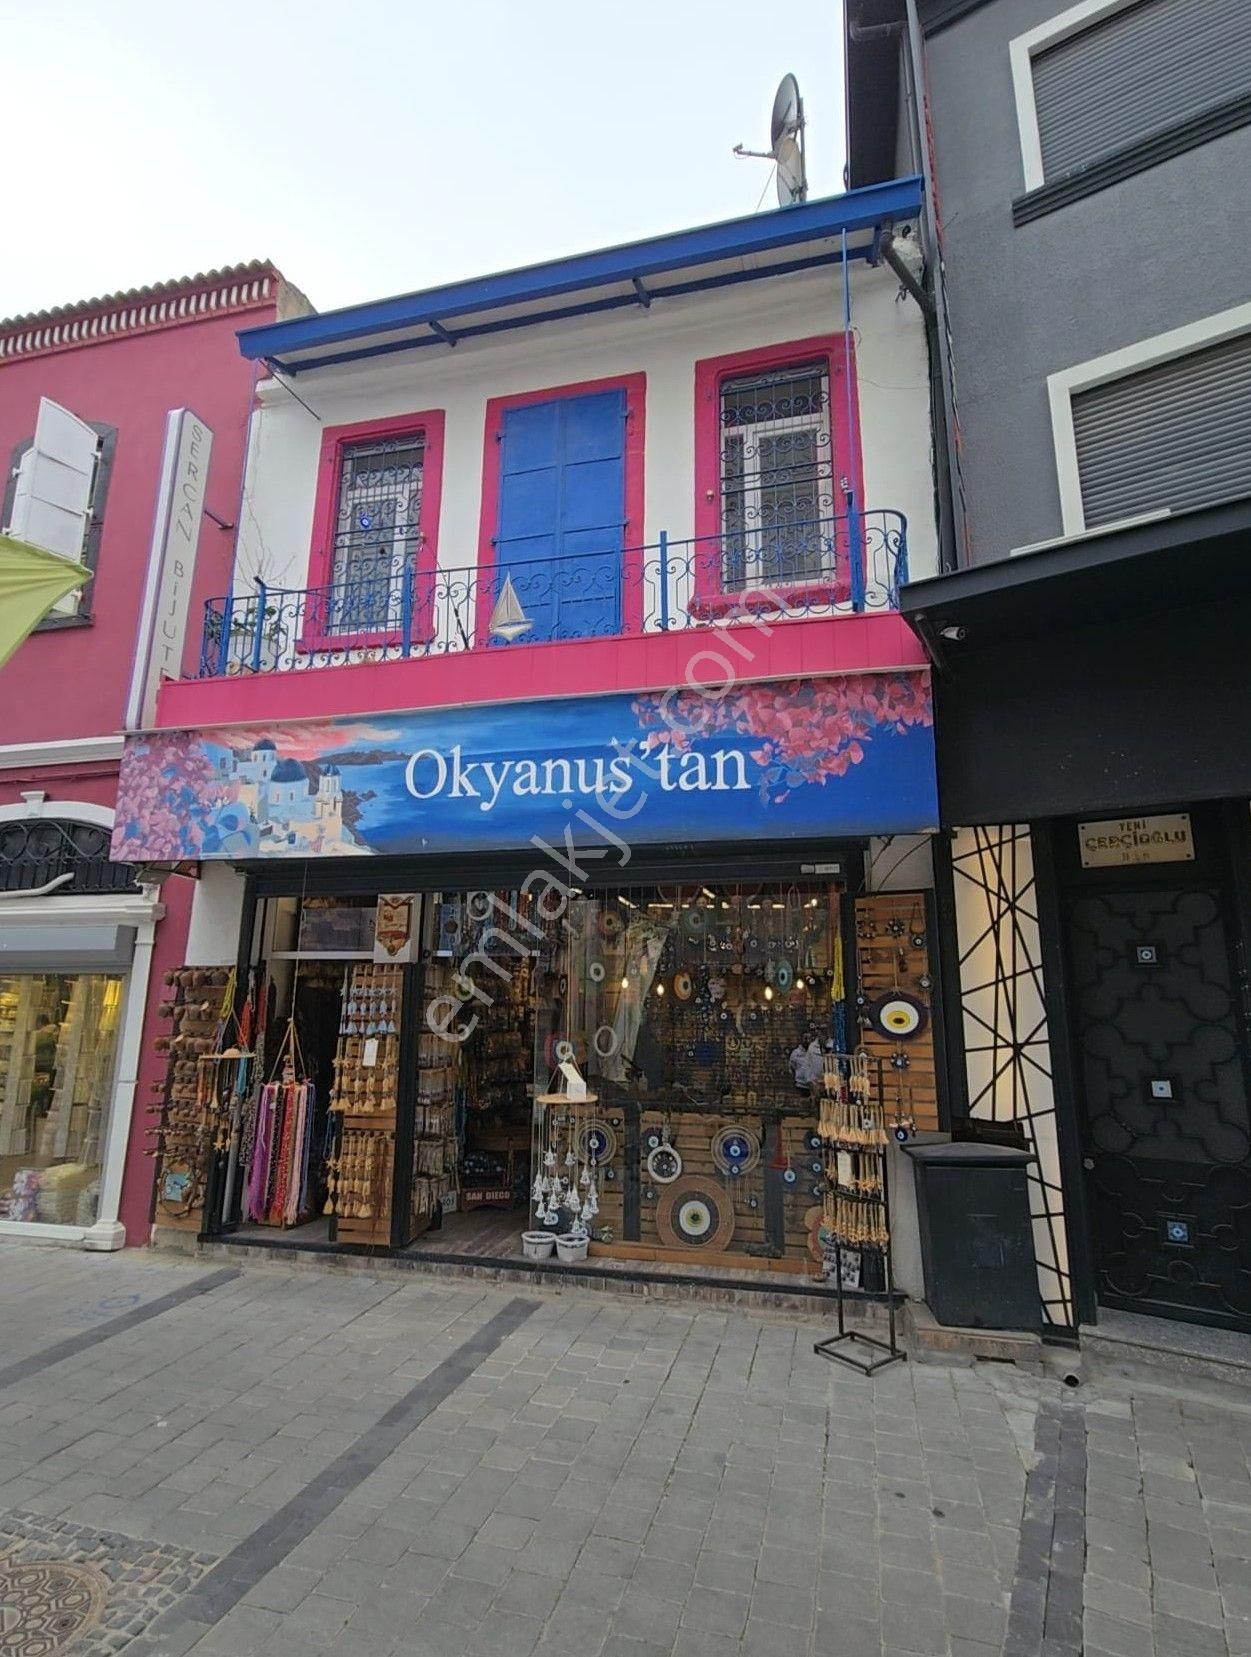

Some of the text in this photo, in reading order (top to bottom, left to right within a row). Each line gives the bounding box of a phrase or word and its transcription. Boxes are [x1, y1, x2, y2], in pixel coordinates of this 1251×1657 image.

[175, 424, 203, 542] SERCAN
[404, 742, 752, 812] Okyanus'tan
[465, 1191, 483, 1201] SAN
[485, 1190, 511, 1200] DIEGO
